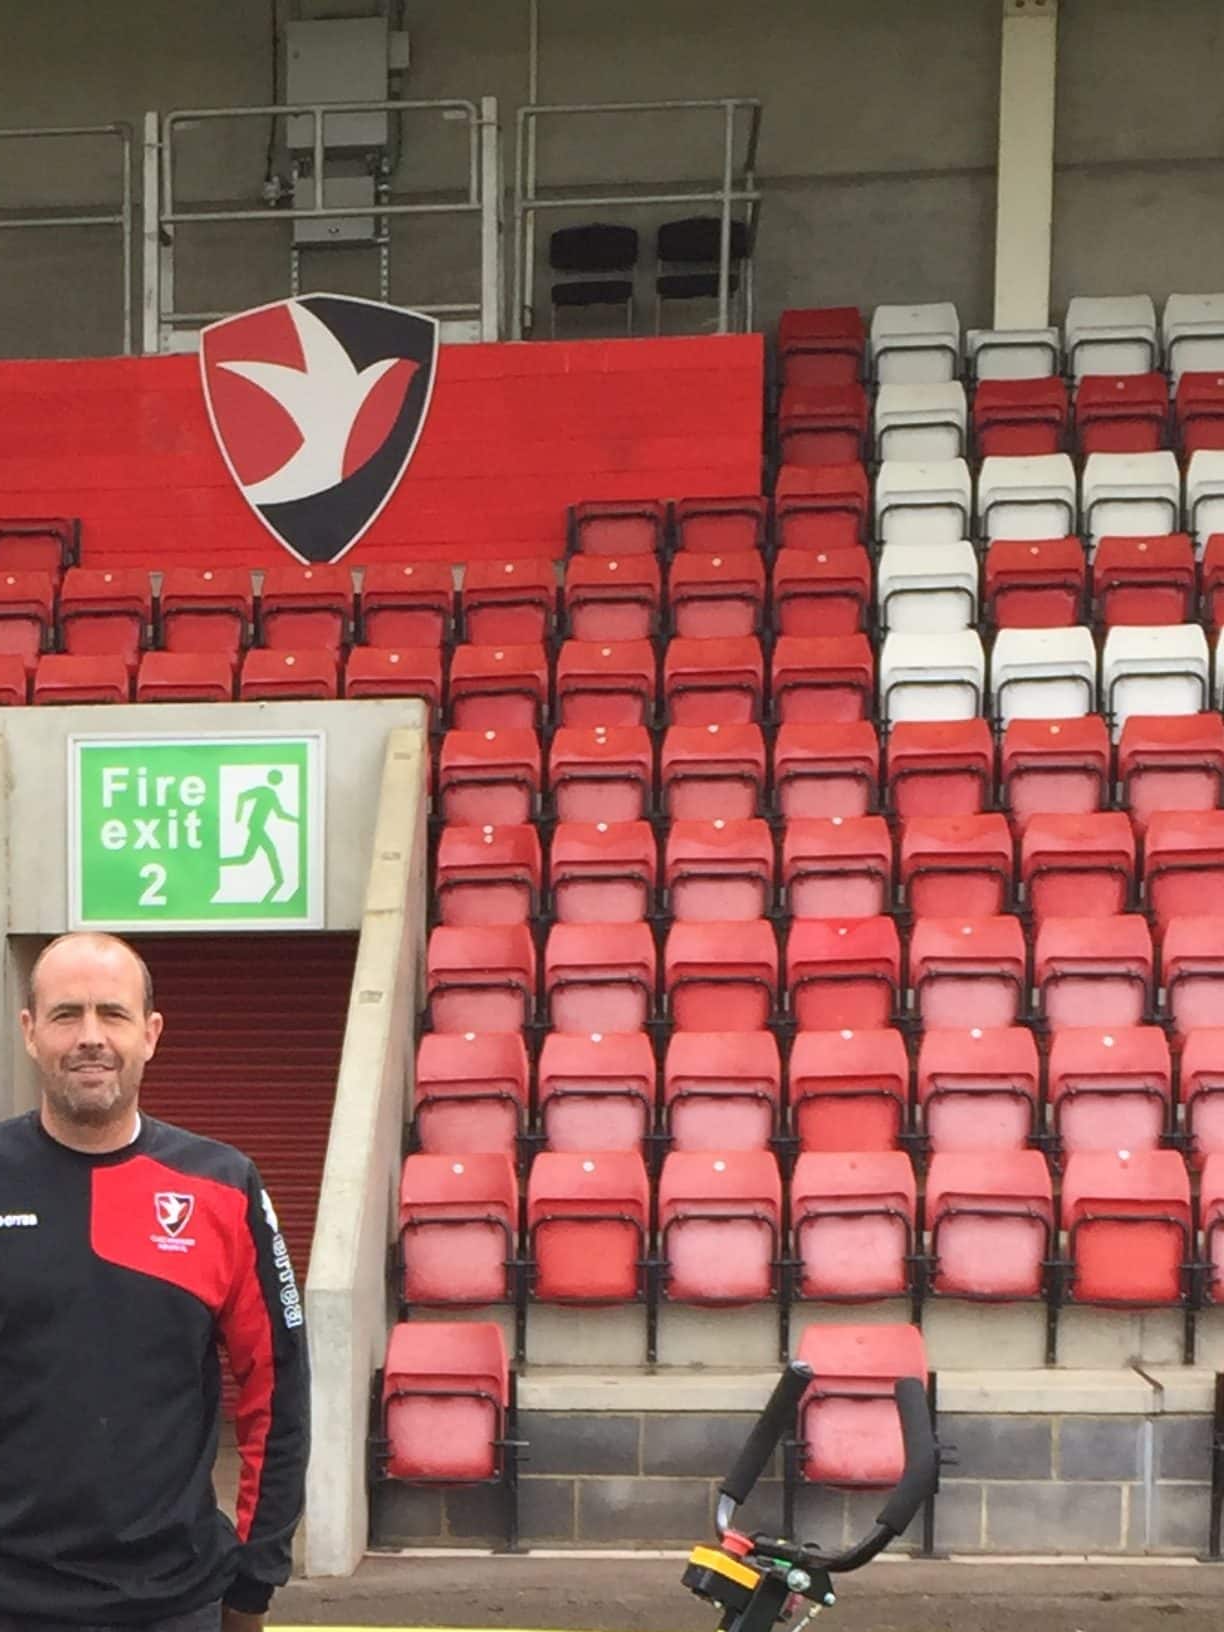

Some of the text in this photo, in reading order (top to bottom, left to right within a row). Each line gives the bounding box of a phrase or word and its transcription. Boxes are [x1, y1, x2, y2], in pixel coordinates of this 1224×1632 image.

[101, 767, 206, 808] Fire
[100, 809, 202, 850] exit
[138, 863, 167, 906] 2
